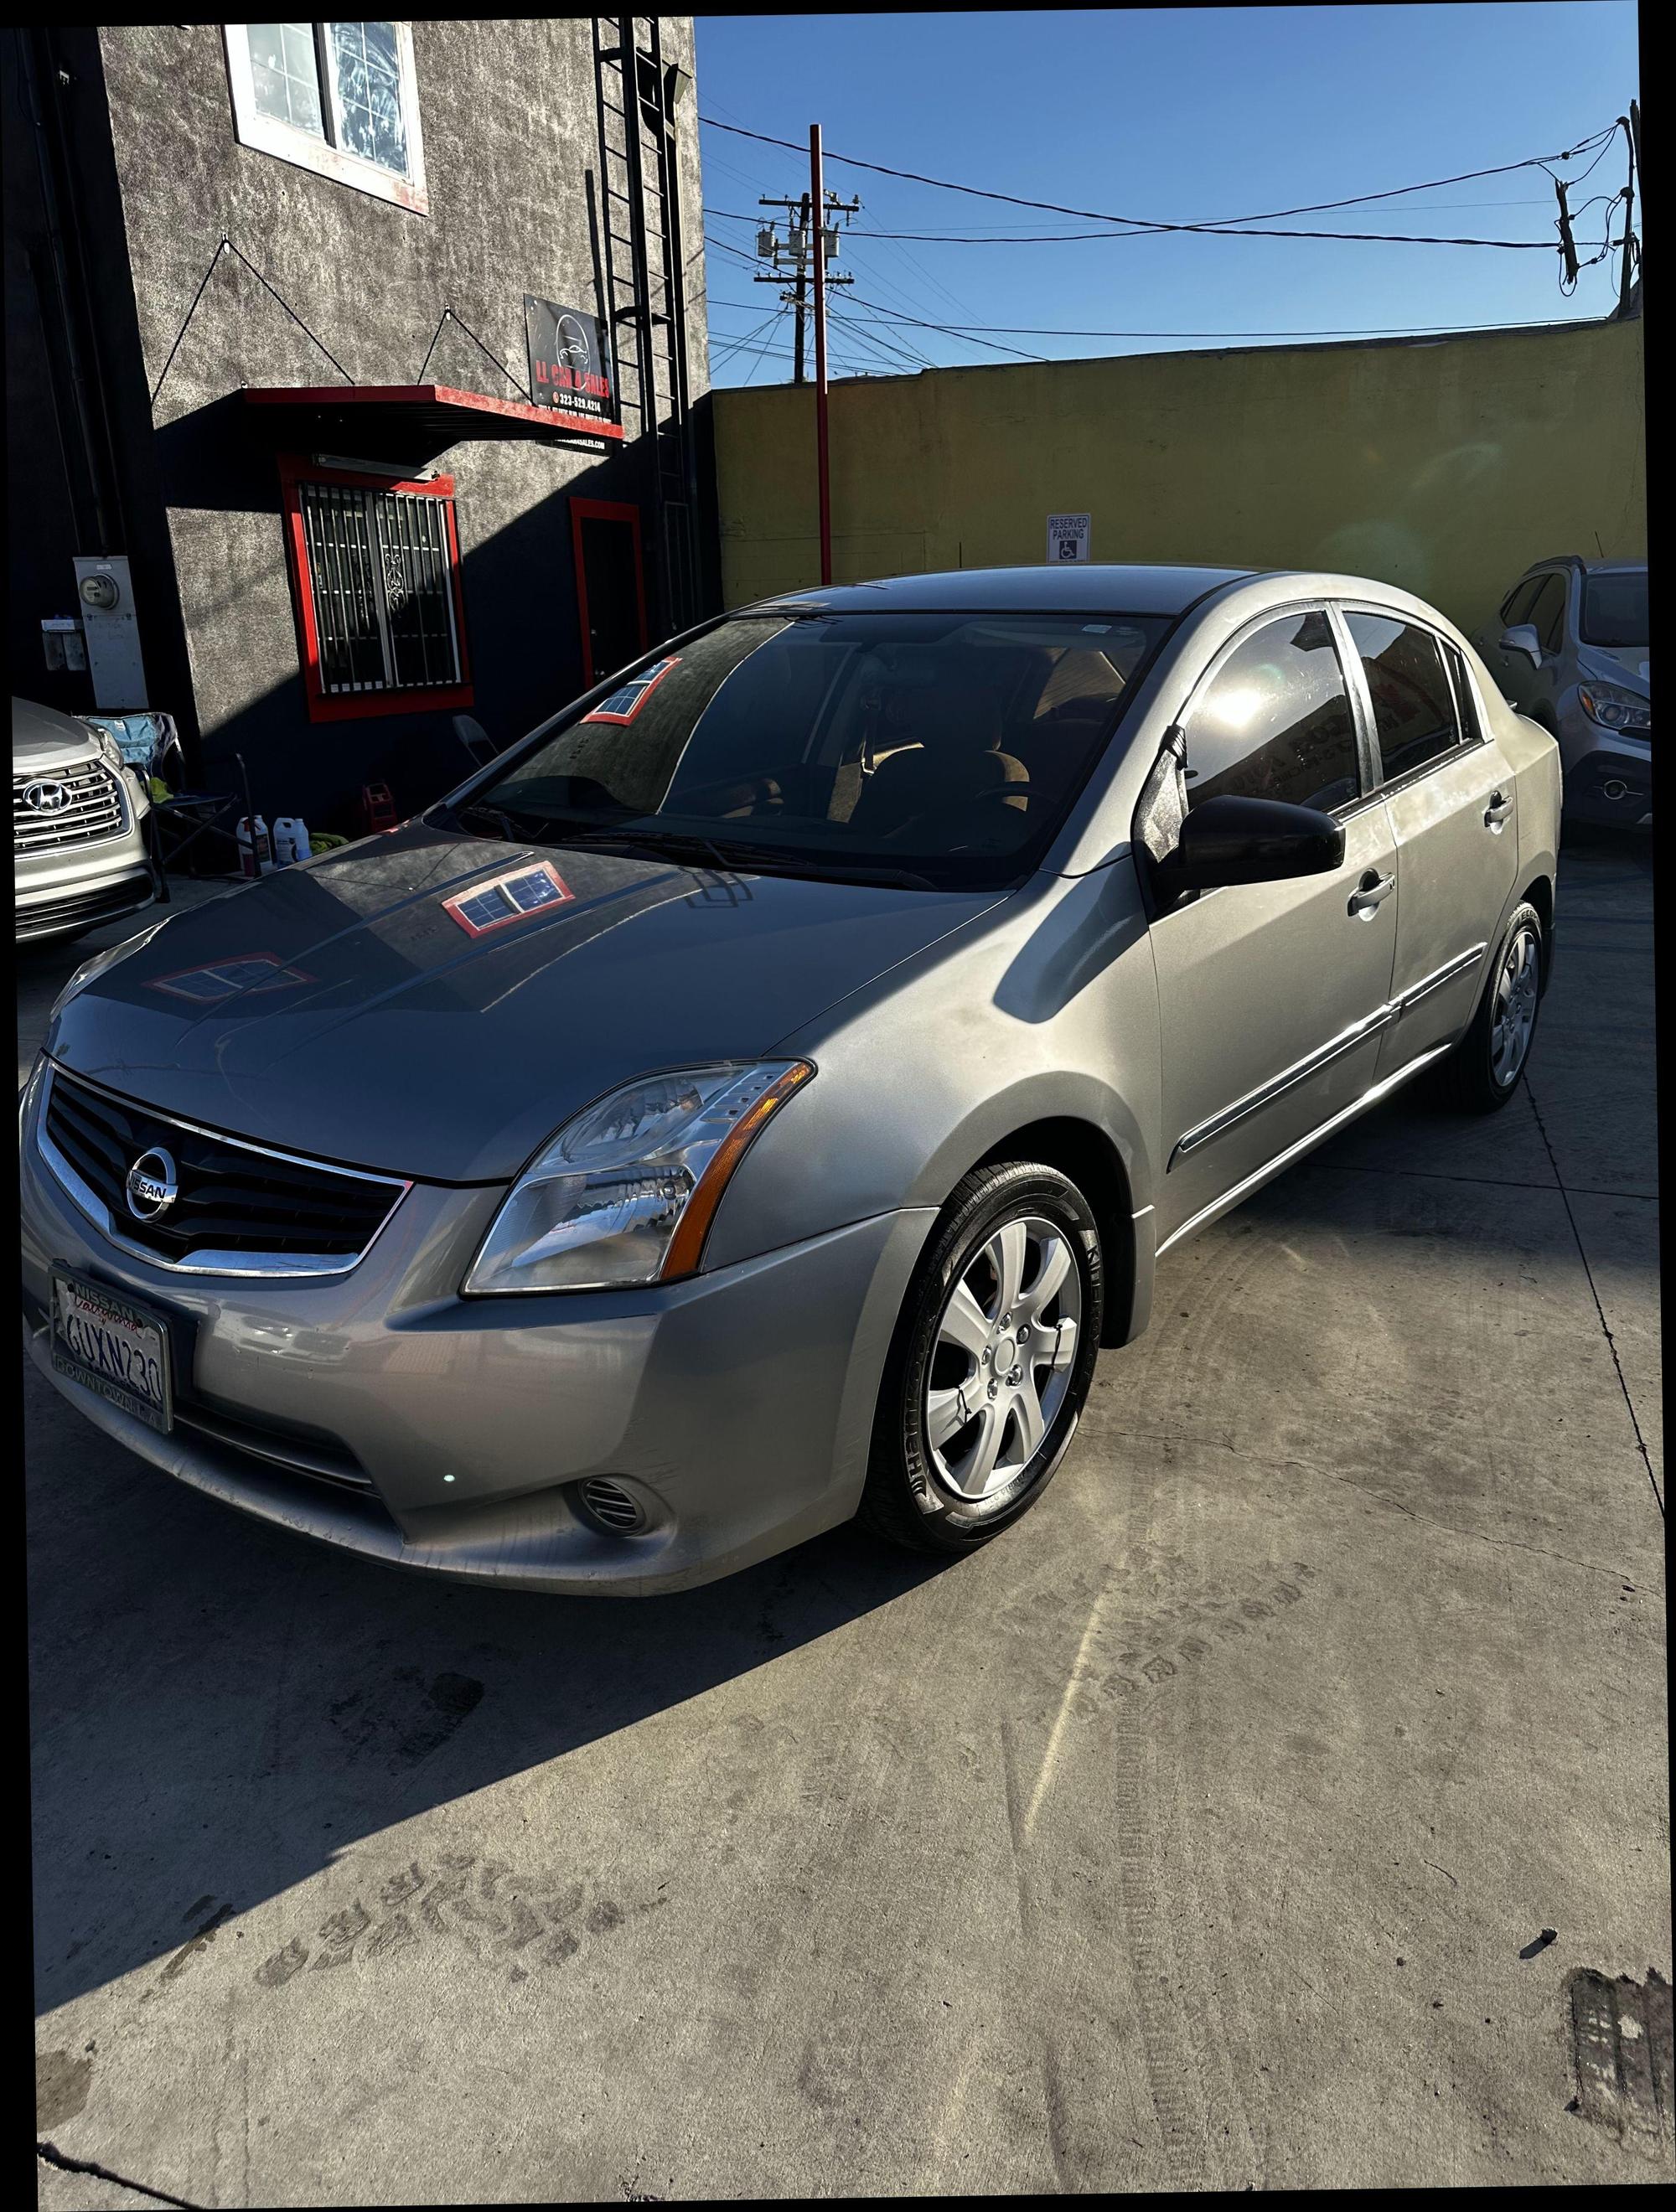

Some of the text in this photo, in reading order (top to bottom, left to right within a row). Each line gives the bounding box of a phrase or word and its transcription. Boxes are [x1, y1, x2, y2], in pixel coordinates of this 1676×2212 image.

[584, 372, 609, 398] SALES
[1050, 517, 1087, 530] RESERVED
[1053, 529, 1084, 540] PARKING
[126, 1170, 167, 1199] NISSAN
[75, 1283, 135, 1322] NISSAN
[56, 1357, 136, 1413] DOWNTOWN
